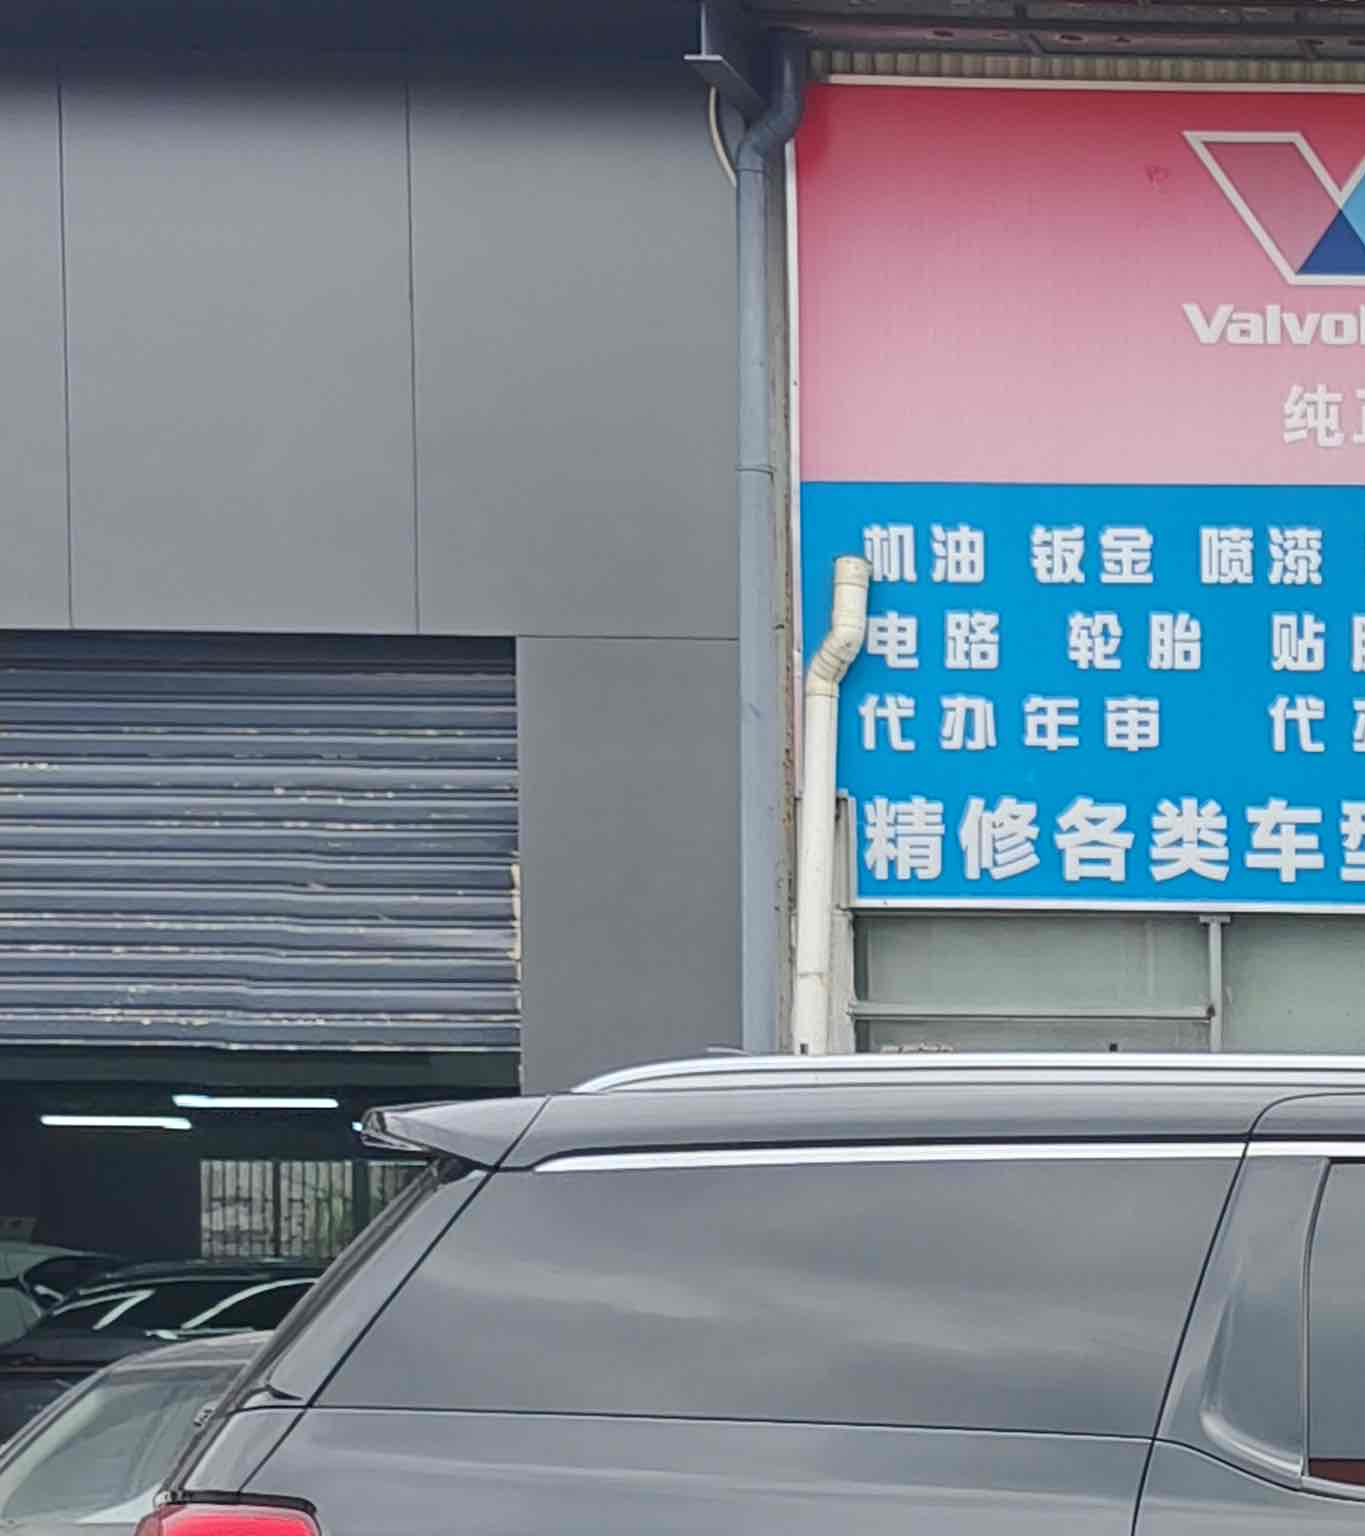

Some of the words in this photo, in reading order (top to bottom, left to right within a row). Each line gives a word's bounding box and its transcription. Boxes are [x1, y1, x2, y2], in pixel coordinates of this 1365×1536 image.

[862, 523, 985, 583] 机油
[1030, 525, 1154, 585] 钣金
[1199, 527, 1322, 586] 喷漆
[866, 611, 999, 670] 电路
[1067, 612, 1202, 672] 轮胎
[858, 695, 1160, 753] 代办年审
